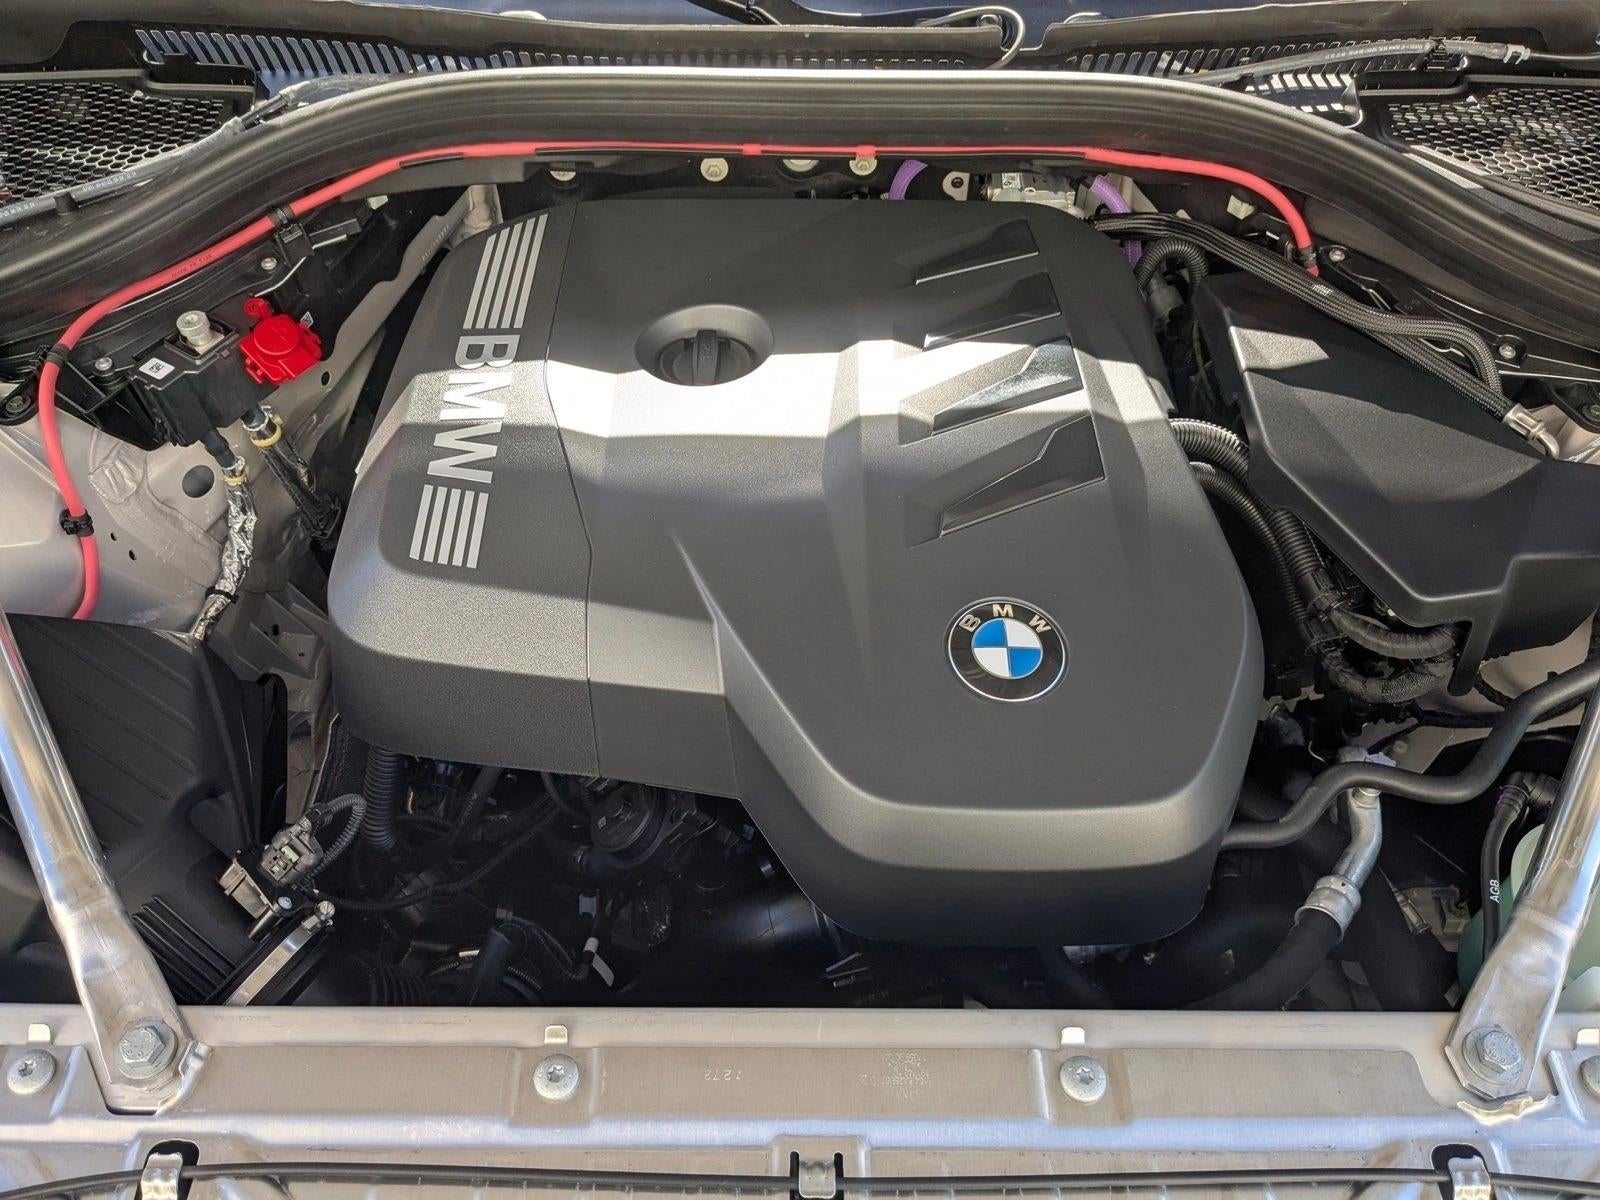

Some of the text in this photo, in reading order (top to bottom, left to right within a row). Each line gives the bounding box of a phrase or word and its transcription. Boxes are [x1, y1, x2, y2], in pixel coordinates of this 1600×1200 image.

[427, 334, 521, 484] BMW
[959, 603, 1052, 634] BMW
[1489, 879, 1500, 904] AGB
